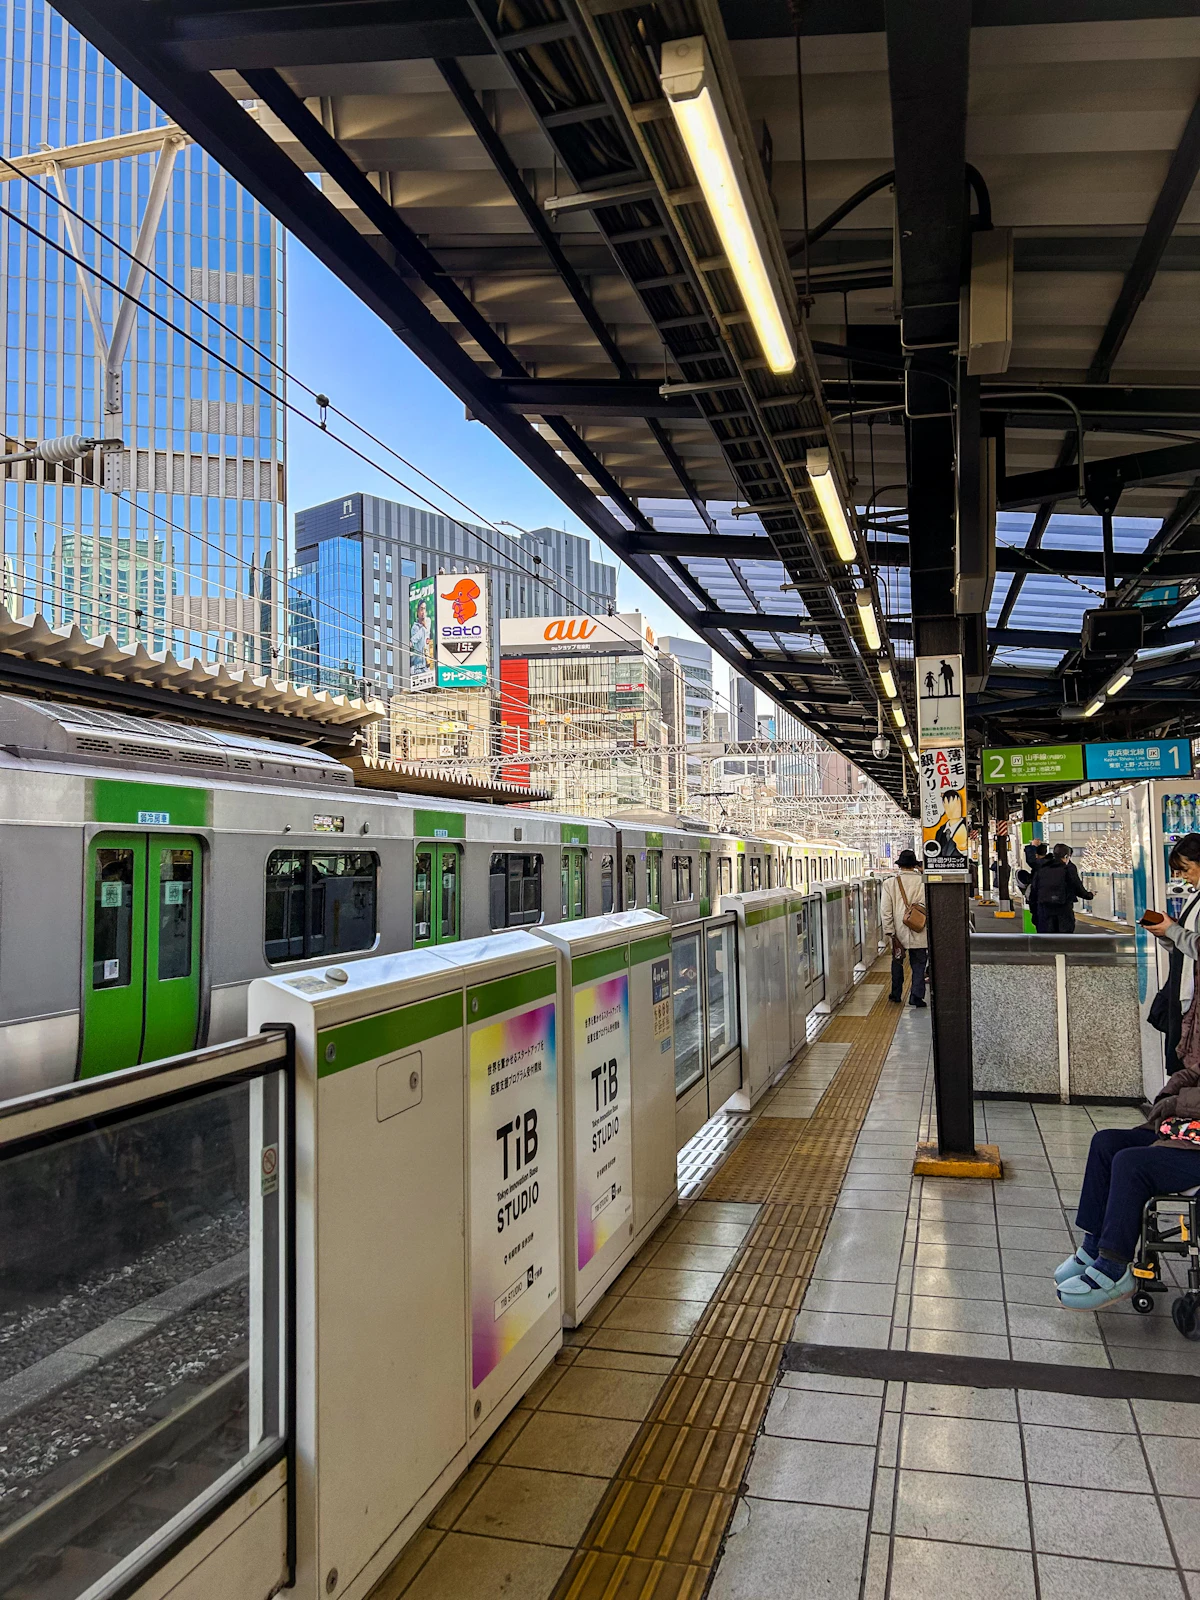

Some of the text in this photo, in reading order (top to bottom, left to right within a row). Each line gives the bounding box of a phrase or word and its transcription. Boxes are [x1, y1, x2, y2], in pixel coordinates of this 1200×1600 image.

[442, 626, 482, 636] sato
[544, 619, 597, 641] au
[947, 749, 964, 775] 薄毛
[1107, 748, 1145, 757] 京浜東北線
[1168, 746, 1180, 769] 1
[920, 753, 936, 791] 銀クリ
[936, 751, 951, 789] AGA
[989, 755, 1006, 778] 2
[140, 813, 168, 824] 弱冷房車
[591, 1058, 618, 1112] TiB
[496, 1108, 538, 1181] TiB
[592, 1116, 619, 1153] STUDIO
[497, 1165, 539, 1202] Tokyo Innovation Base
[497, 1181, 539, 1234] STUDIO
[508, 1282, 523, 1302] STUDIO
